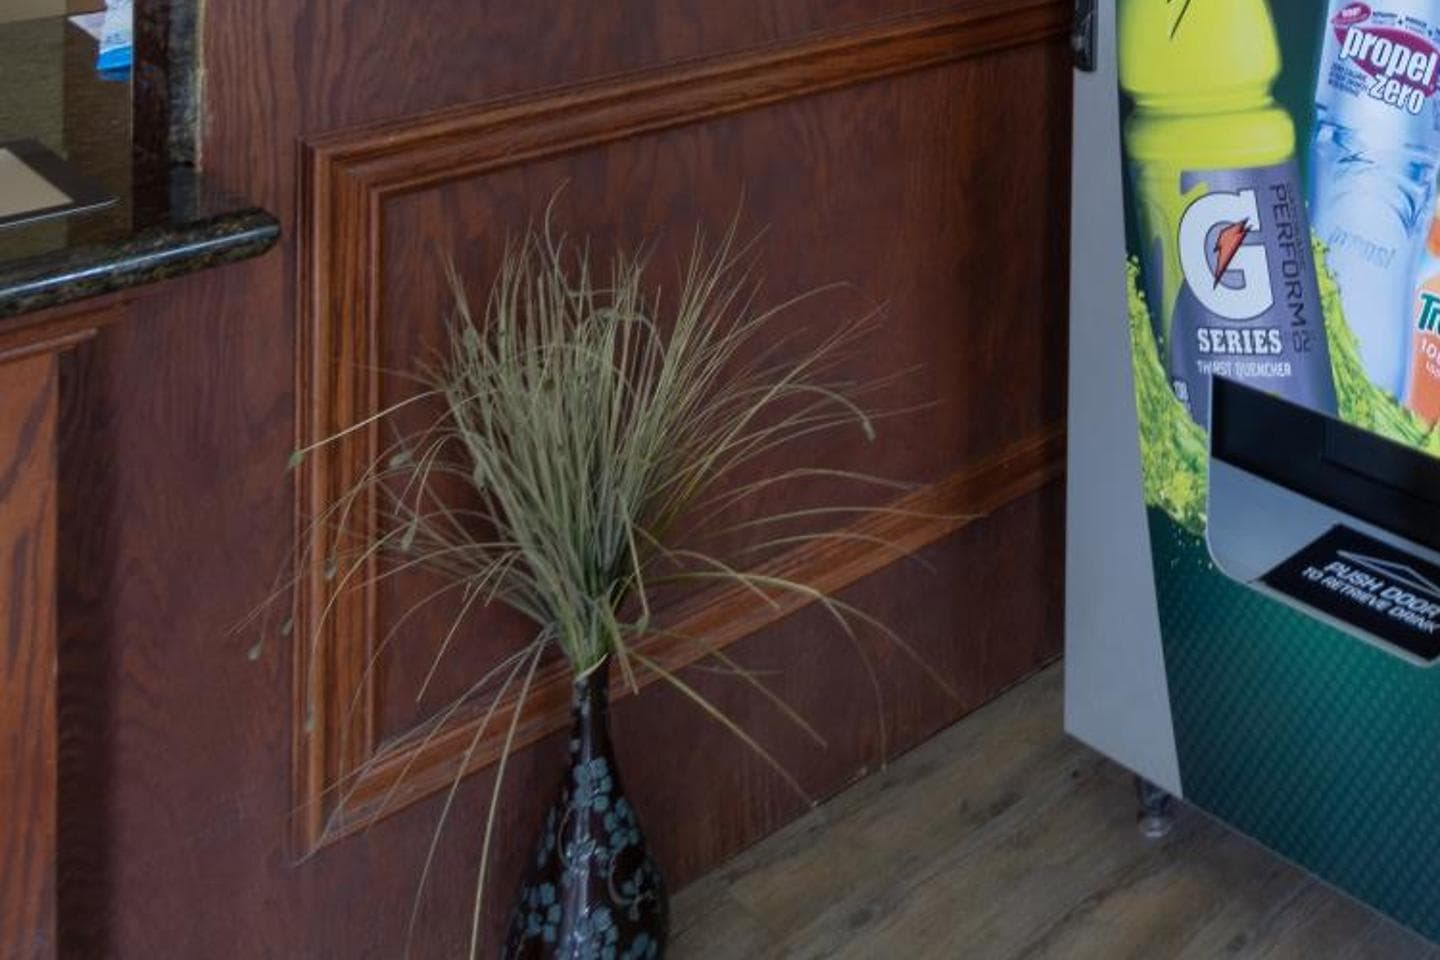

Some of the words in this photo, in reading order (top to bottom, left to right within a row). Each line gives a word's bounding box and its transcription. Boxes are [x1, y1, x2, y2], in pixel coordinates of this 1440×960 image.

[1338, 26, 1440, 87] propel
[1367, 74, 1424, 116] zero
[1178, 189, 1276, 321] G
[1270, 183, 1307, 327] PERFORM
[1197, 327, 1282, 354] SERIES
[1302, 565, 1324, 581] TO
[1320, 573, 1389, 613] RETRIEVE
[1386, 602, 1440, 634] DRINK
[1324, 561, 1385, 591] PUSH
